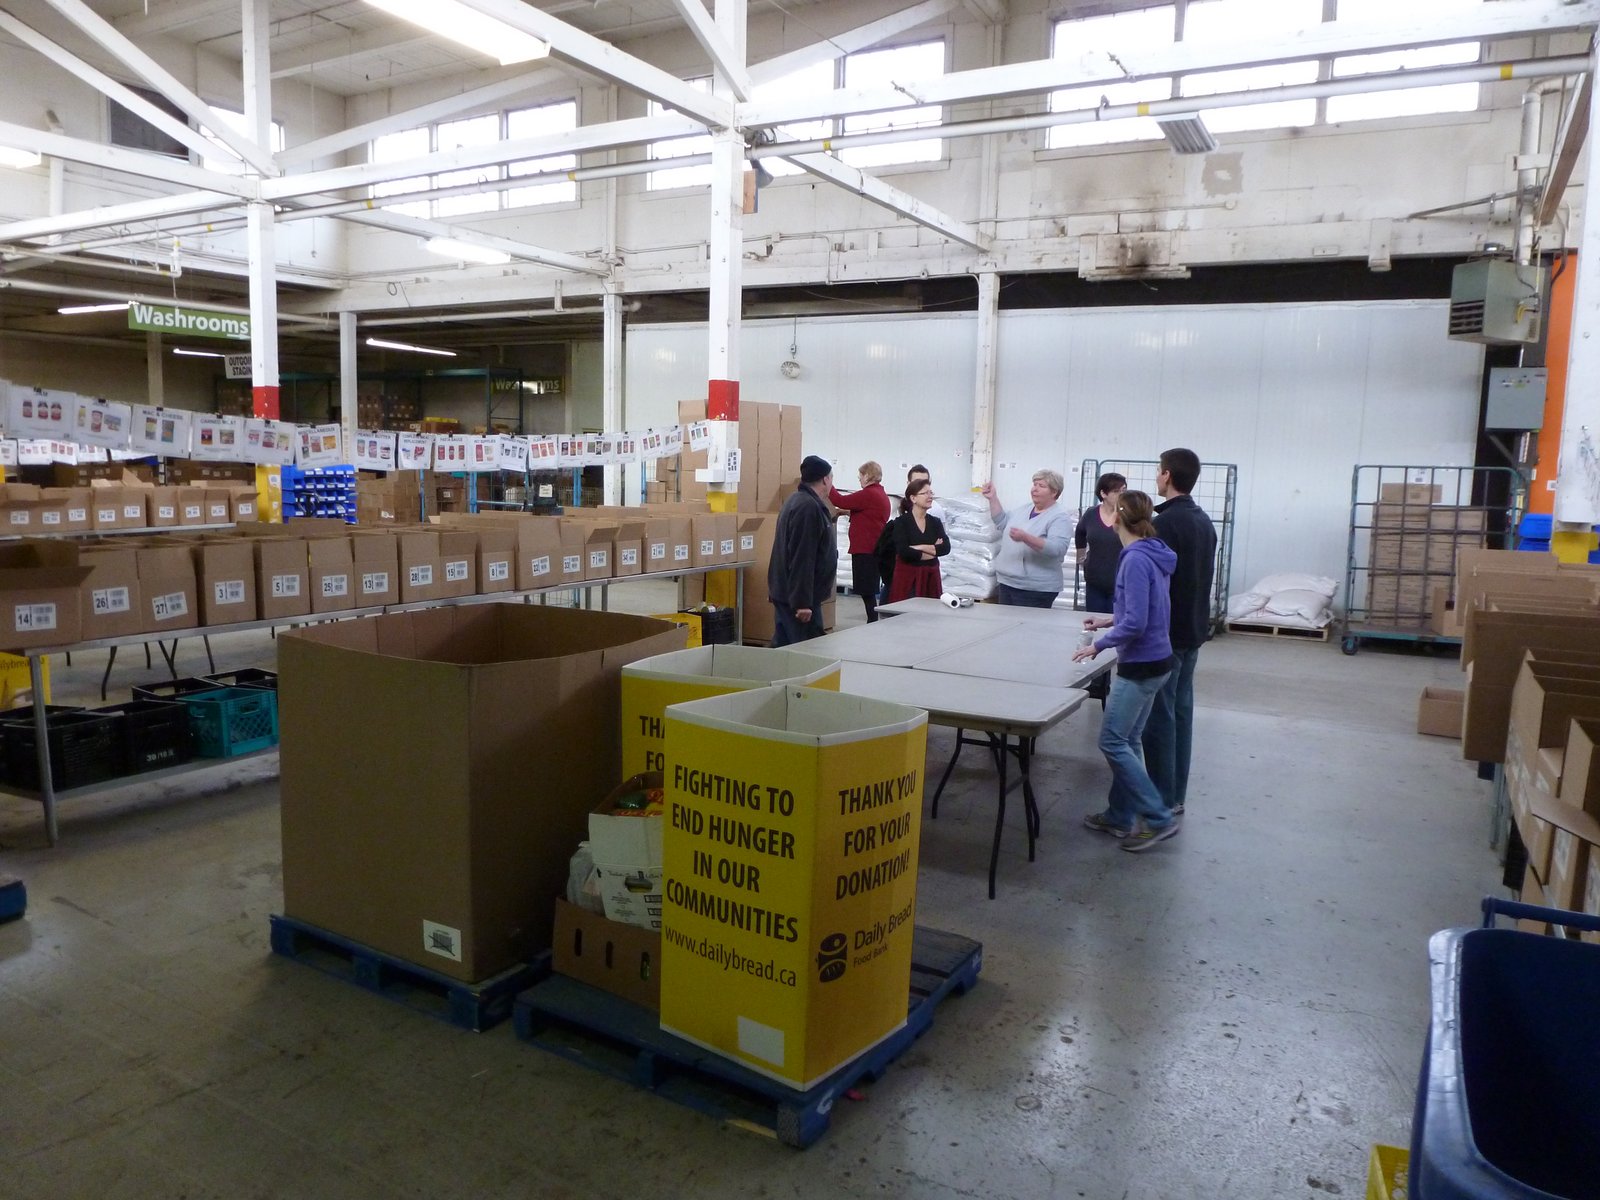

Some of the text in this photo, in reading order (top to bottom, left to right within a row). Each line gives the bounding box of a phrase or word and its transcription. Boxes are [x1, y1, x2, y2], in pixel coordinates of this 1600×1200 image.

[133, 304, 249, 334] Washrooms
[229, 356, 252, 366] OUTGOI
[232, 366, 252, 376] STAGIN
[448, 568, 454, 577] 15
[219, 589, 224, 599] 3
[276, 582, 280, 592] 5
[324, 582, 331, 592] 25
[364, 580, 372, 589] 13
[96, 598, 106, 609] 26
[156, 604, 165, 614] 27
[18, 614, 29, 625] 14
[639, 715, 665, 739] TH
[646, 750, 665, 771] FO
[674, 764, 760, 810] FIGHTING
[766, 787, 795, 817] TO
[838, 769, 917, 815] THANK YOU
[672, 802, 795, 860] END HUNGER
[844, 812, 910, 857] FOR YOUR
[693, 850, 760, 893] IN OUR
[836, 848, 910, 901] DONATION!
[666, 878, 799, 943] COMMUNITIES
[854, 898, 913, 951] Daily Bread
[665, 925, 797, 987] www.dailybread.ca
[853, 950, 872, 969] Food
